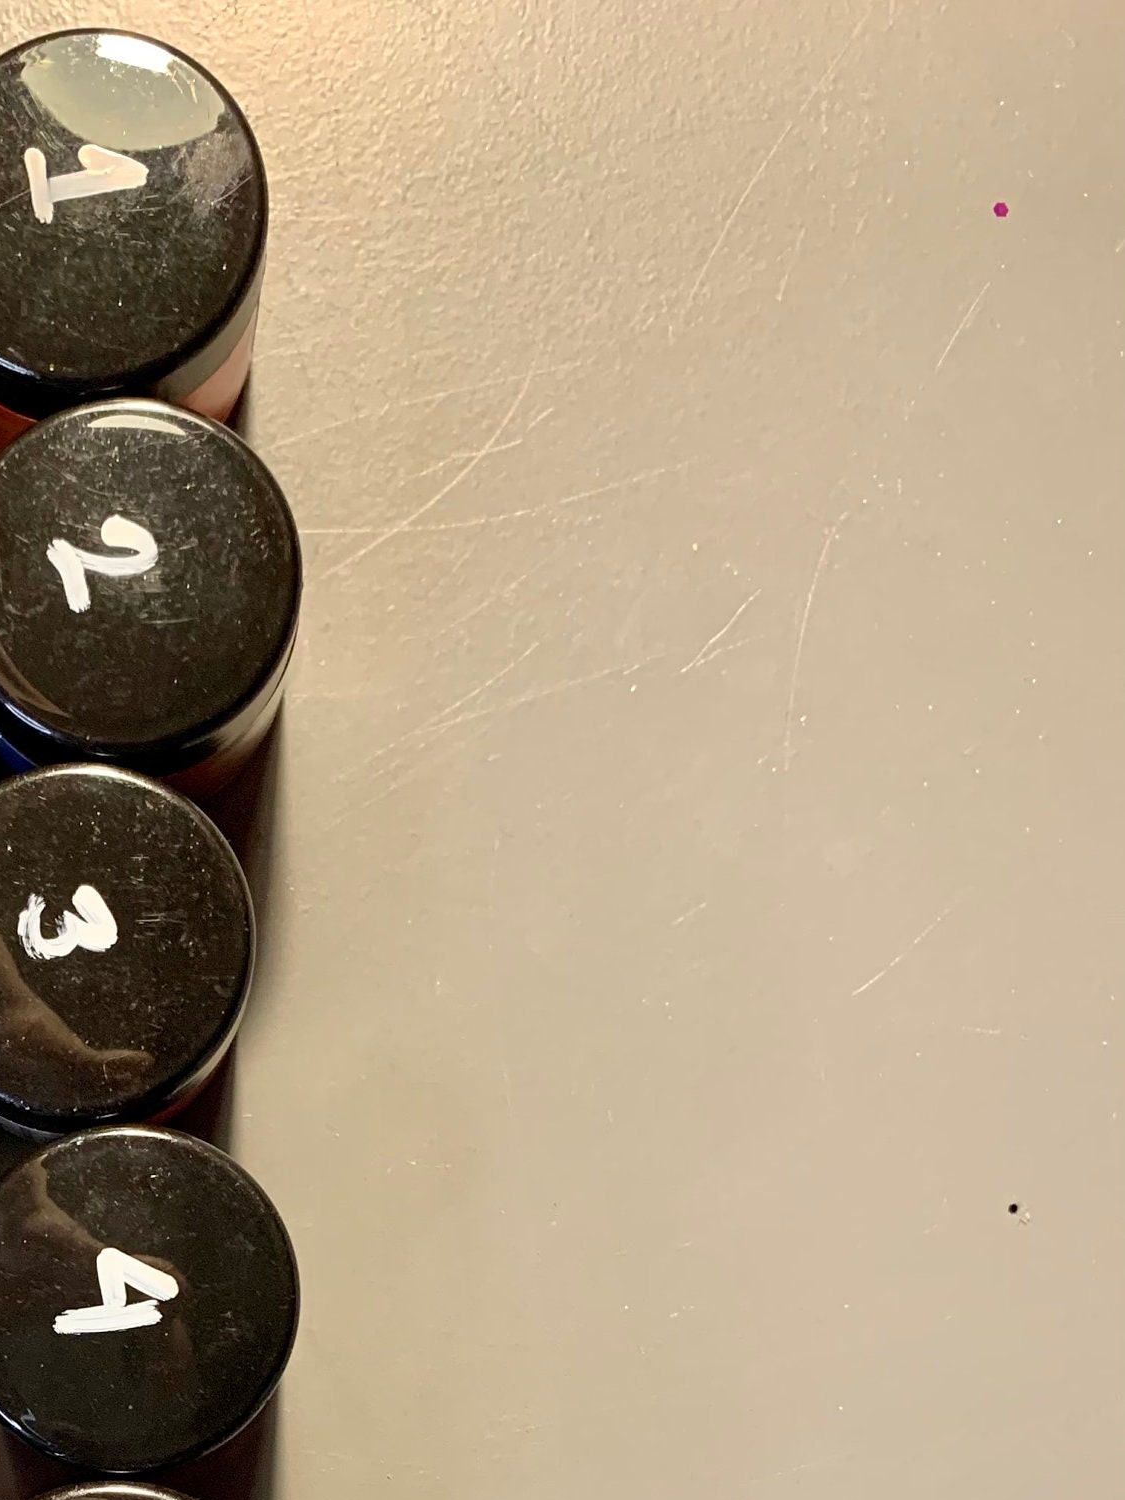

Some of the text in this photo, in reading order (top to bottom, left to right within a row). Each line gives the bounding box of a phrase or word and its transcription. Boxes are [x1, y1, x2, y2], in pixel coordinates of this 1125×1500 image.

[24, 143, 150, 225] 1
[47, 514, 158, 613] 2
[18, 885, 118, 959] 3
[53, 1248, 178, 1334] 4
